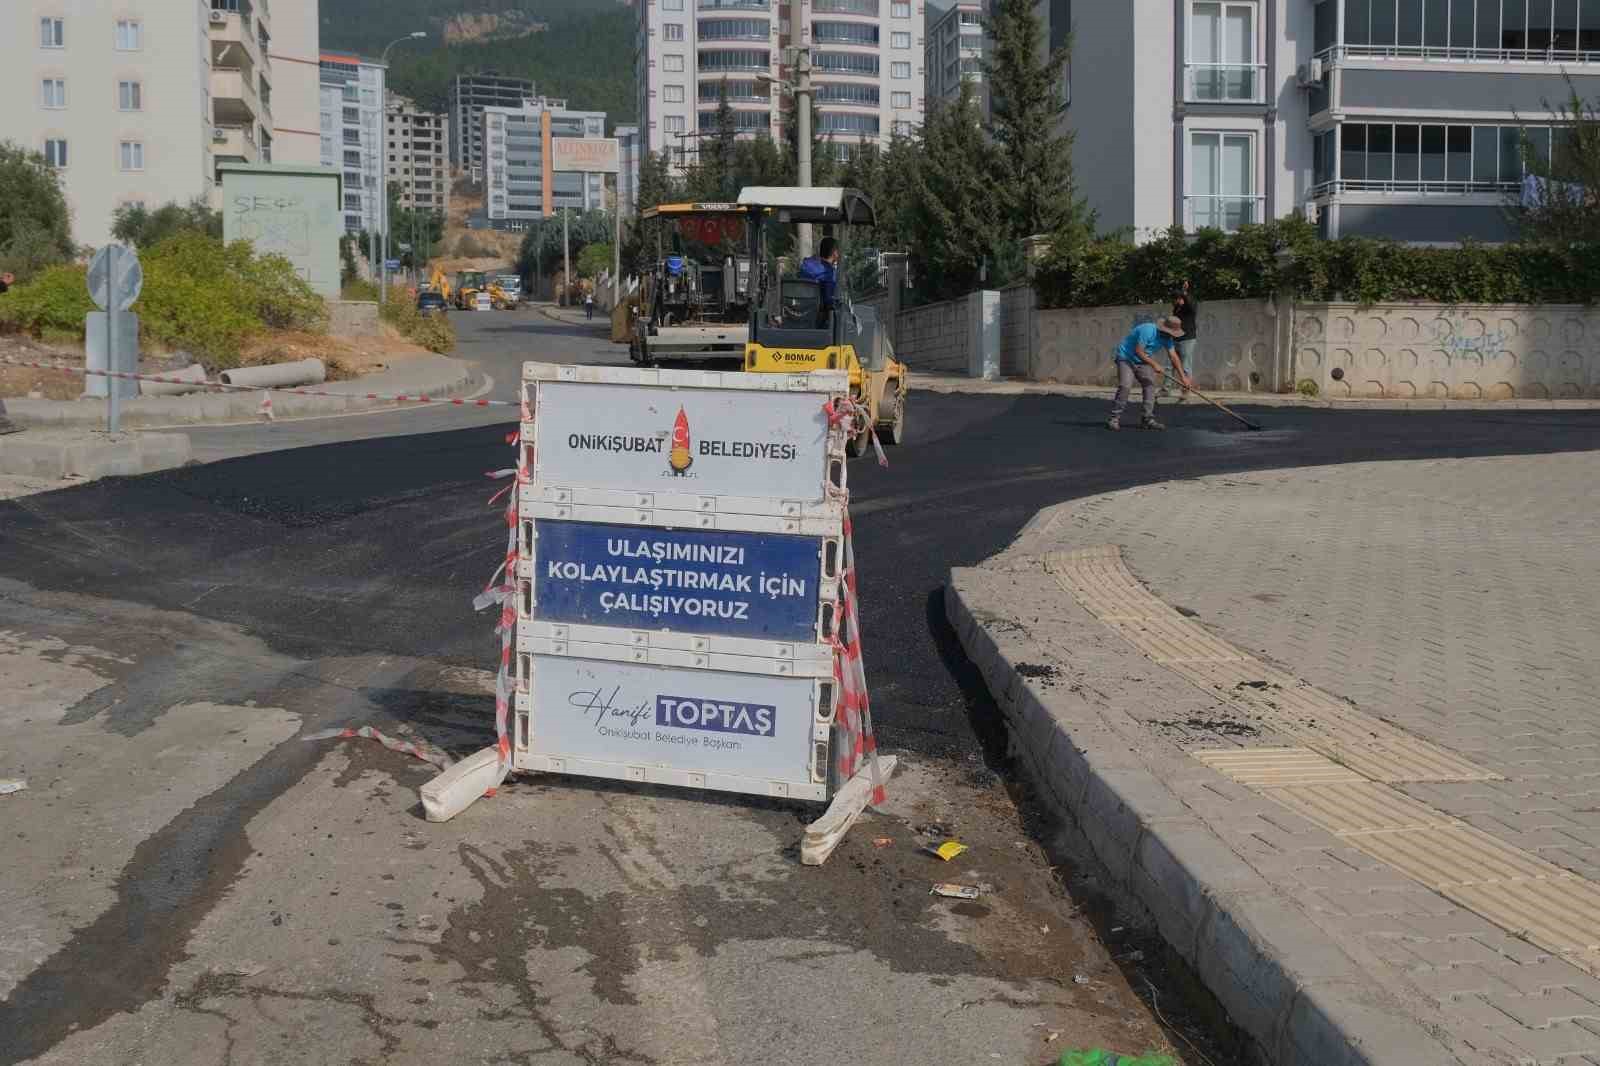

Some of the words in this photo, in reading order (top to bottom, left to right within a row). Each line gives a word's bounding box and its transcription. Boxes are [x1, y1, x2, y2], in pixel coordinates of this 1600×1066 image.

[784, 352, 816, 362] BOMAG
[607, 538, 745, 565] ULAŞIMINIZI
[548, 560, 752, 593] KOLAYLAŞTIRMAK
[759, 571, 806, 600] İÇİN
[599, 592, 749, 620] ÇALIŞIYORUZ
[568, 686, 653, 727] Hanifi
[660, 699, 772, 736] TOPTAŞ
[655, 732, 698, 745] Belediye
